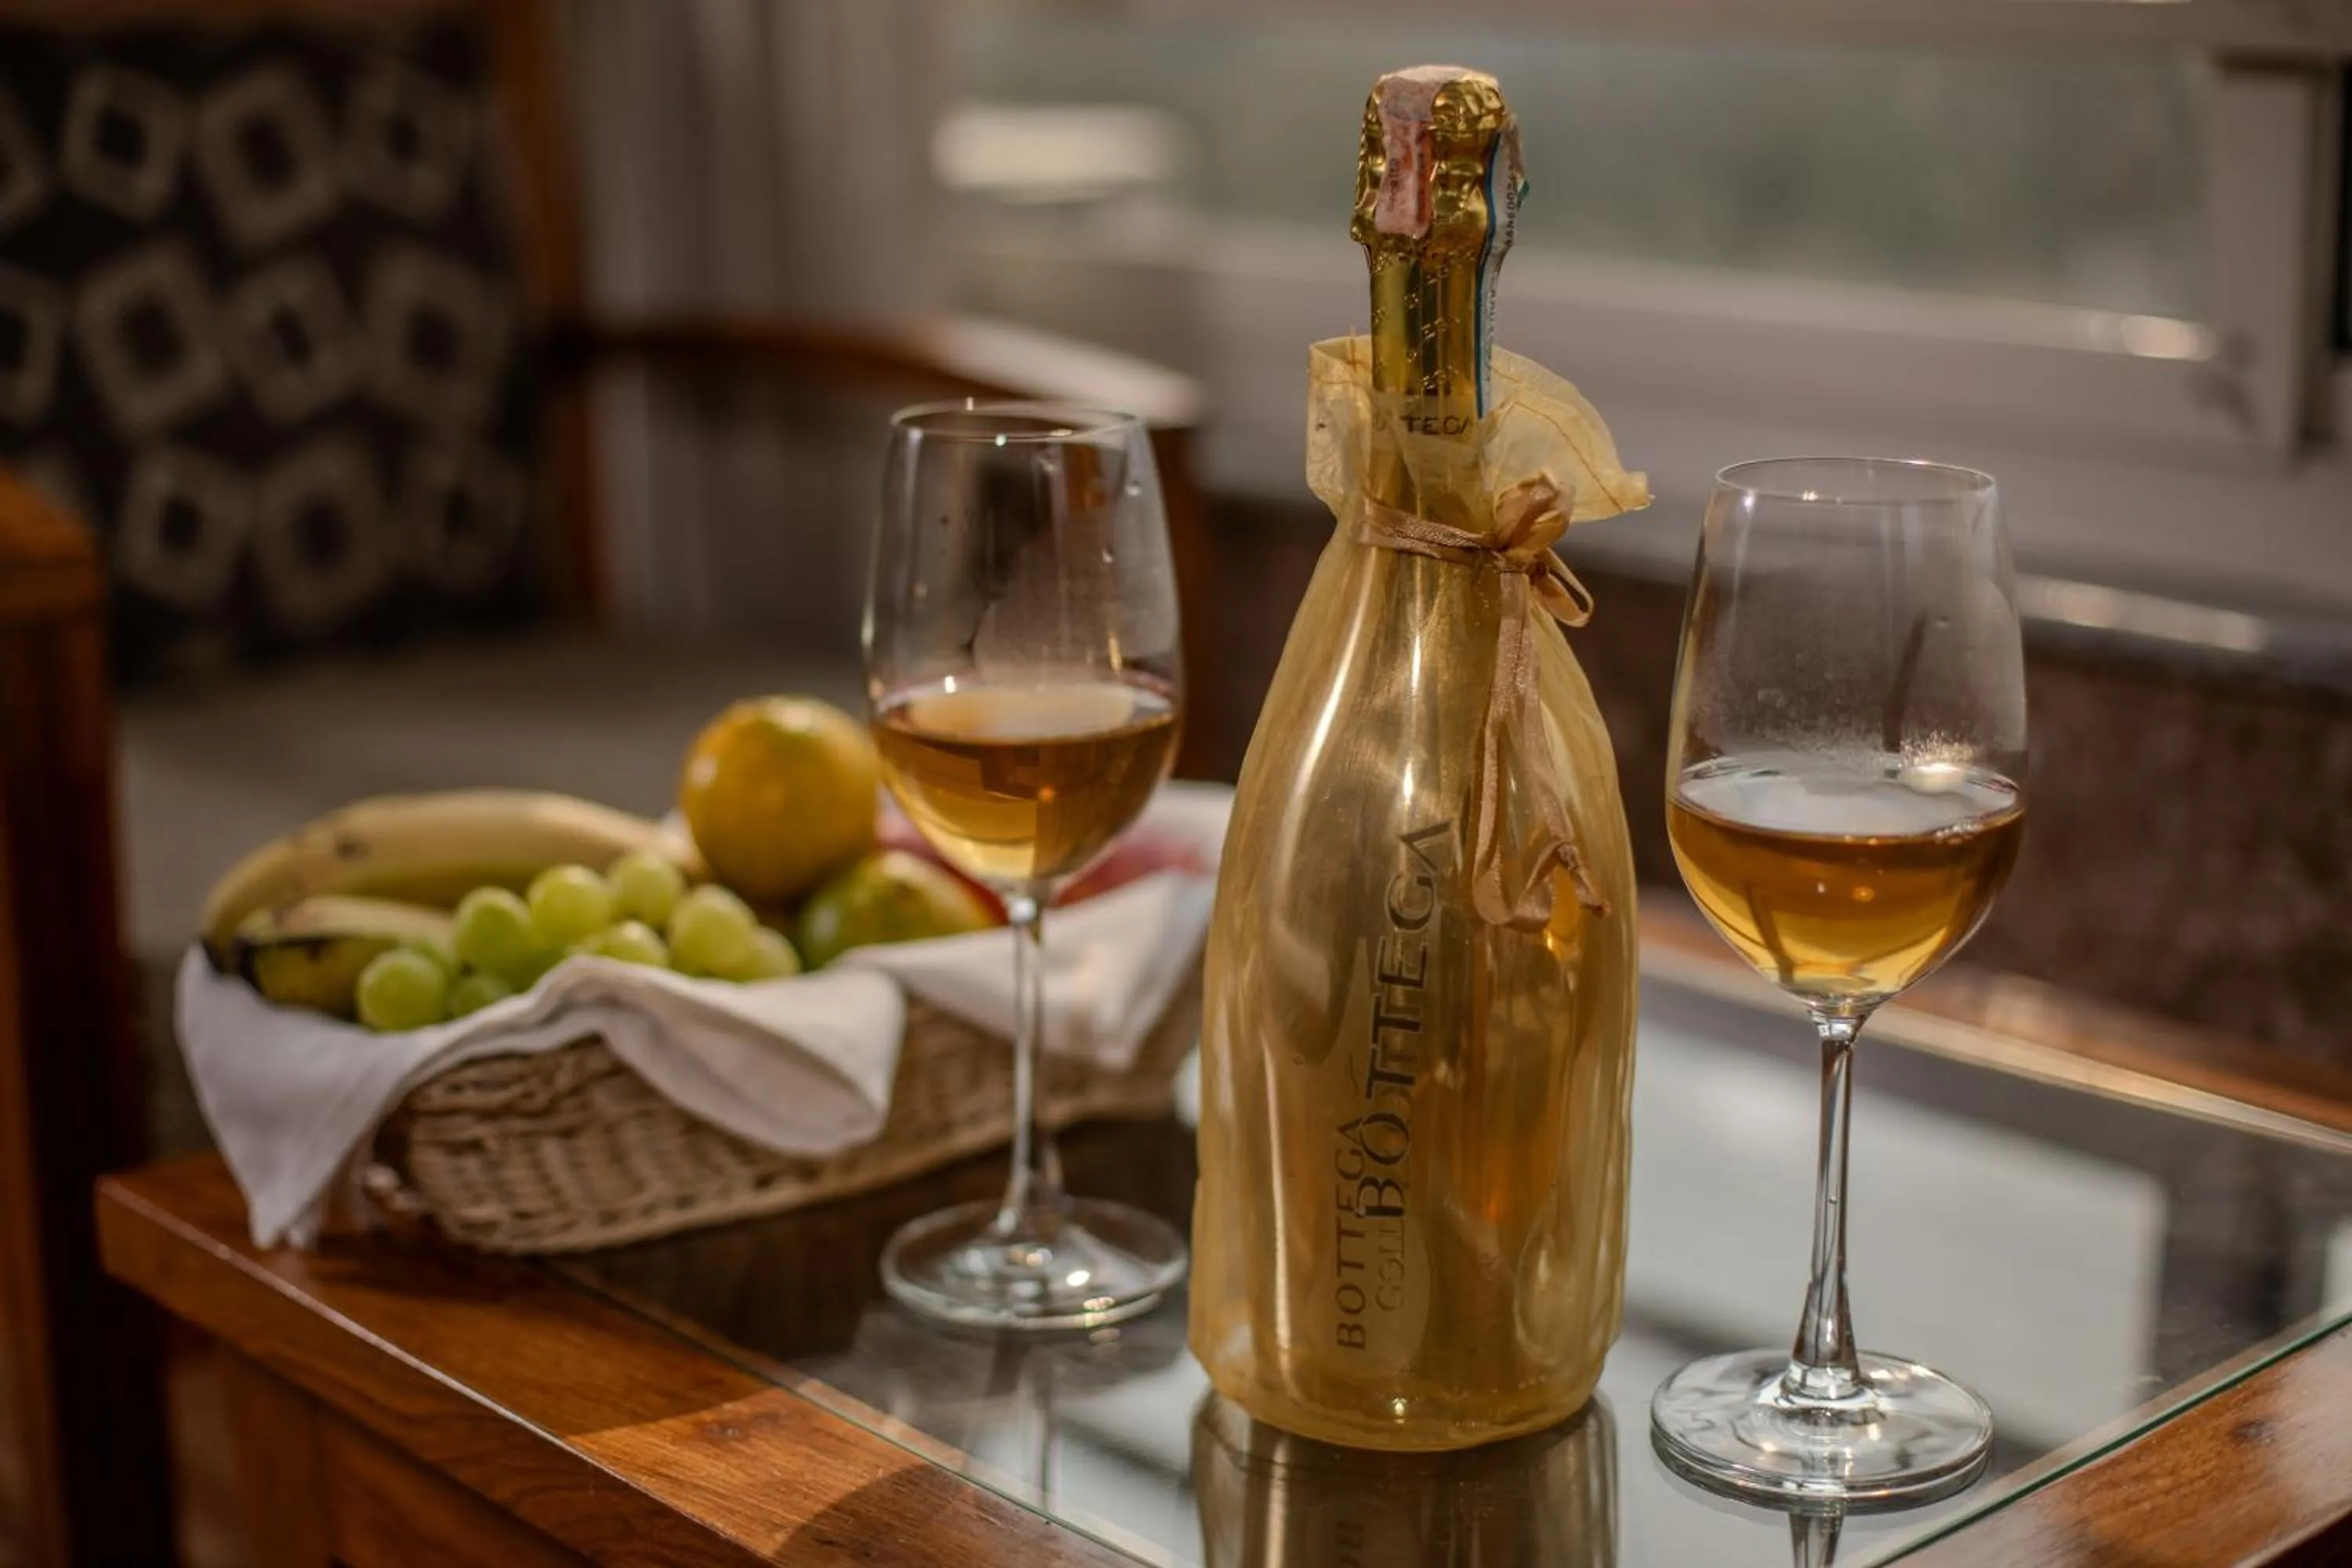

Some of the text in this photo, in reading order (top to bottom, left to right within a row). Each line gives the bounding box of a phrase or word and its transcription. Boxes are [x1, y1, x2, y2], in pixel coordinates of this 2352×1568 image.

[1356, 822, 1451, 1218] BOTTEGA
[1335, 1115, 1367, 1350] BOTTEGA
[1375, 1217, 1405, 1312] GOL
